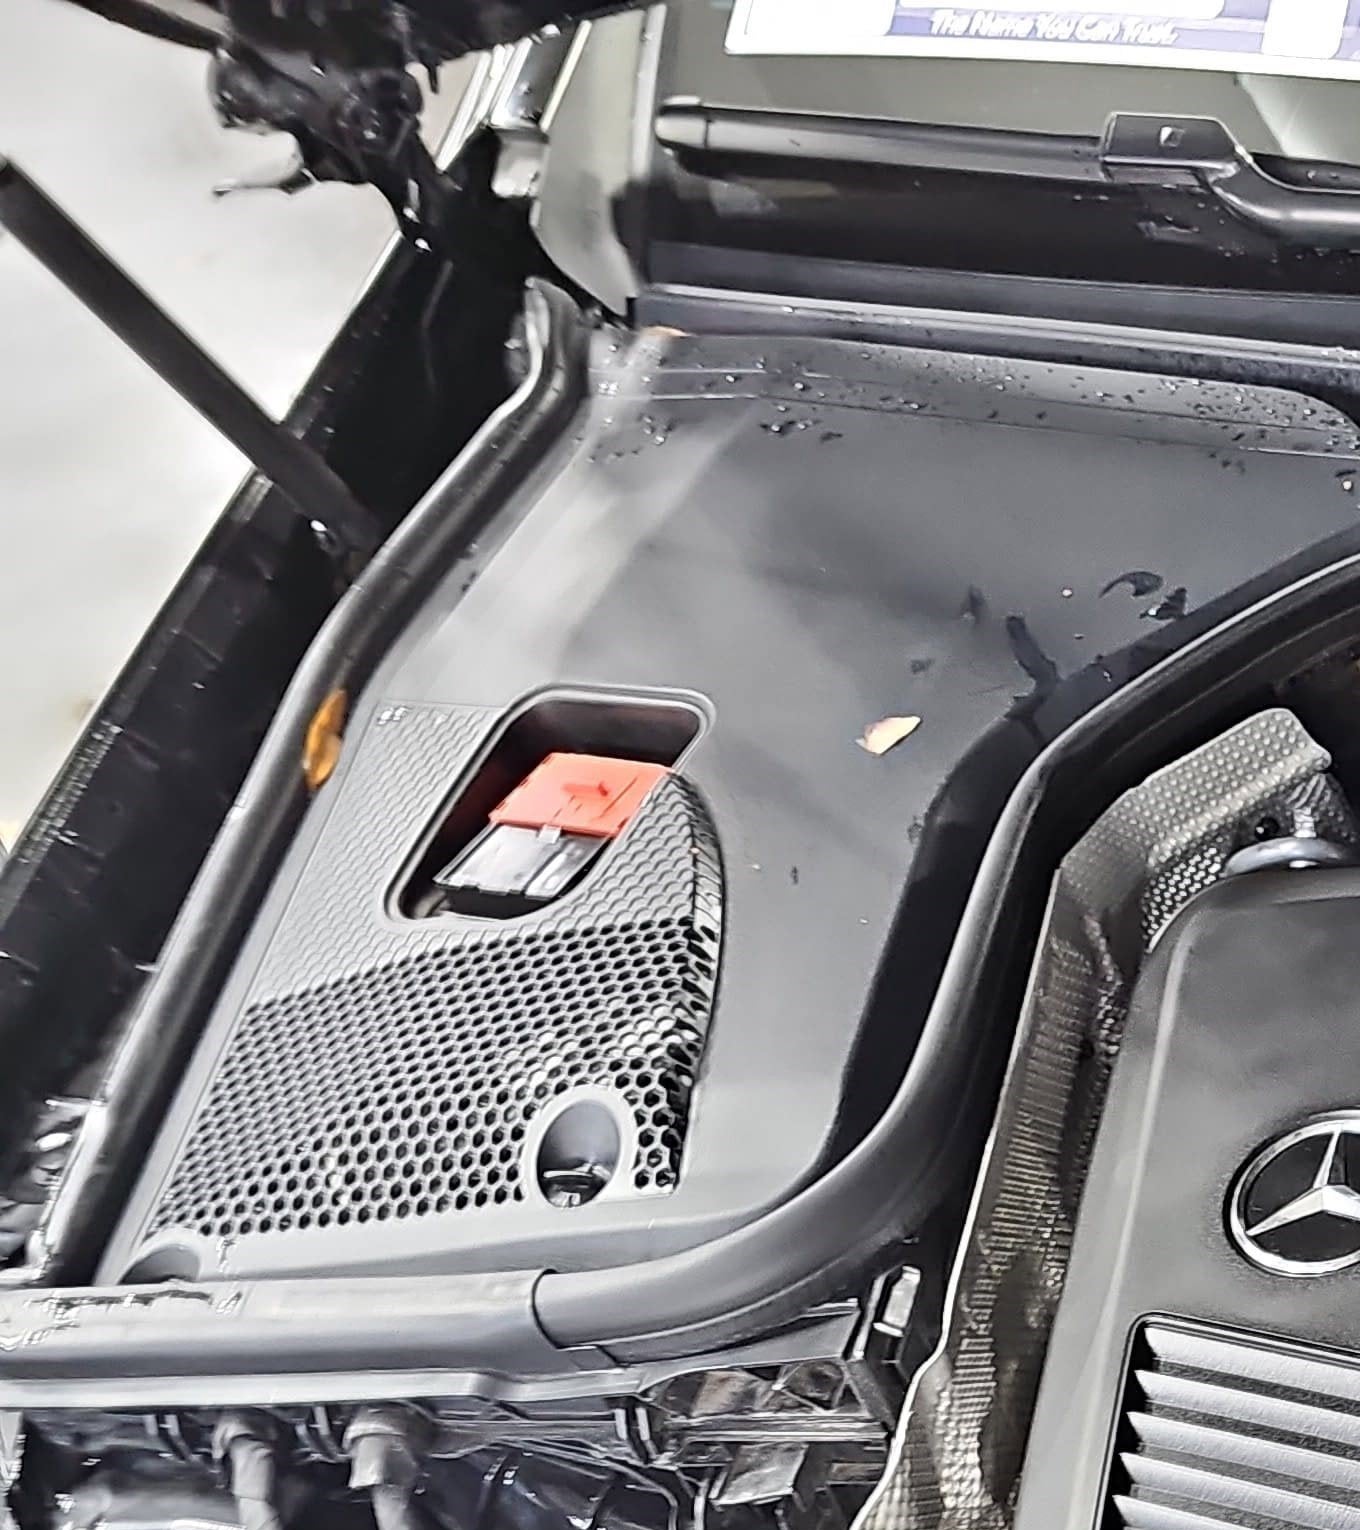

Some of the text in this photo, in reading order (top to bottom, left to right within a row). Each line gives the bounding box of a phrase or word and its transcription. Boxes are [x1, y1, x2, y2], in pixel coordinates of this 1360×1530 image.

[930, 8, 969, 37] The
[969, 10, 1033, 38] Name
[1033, 12, 1076, 40] You
[1076, 14, 1120, 42] Can
